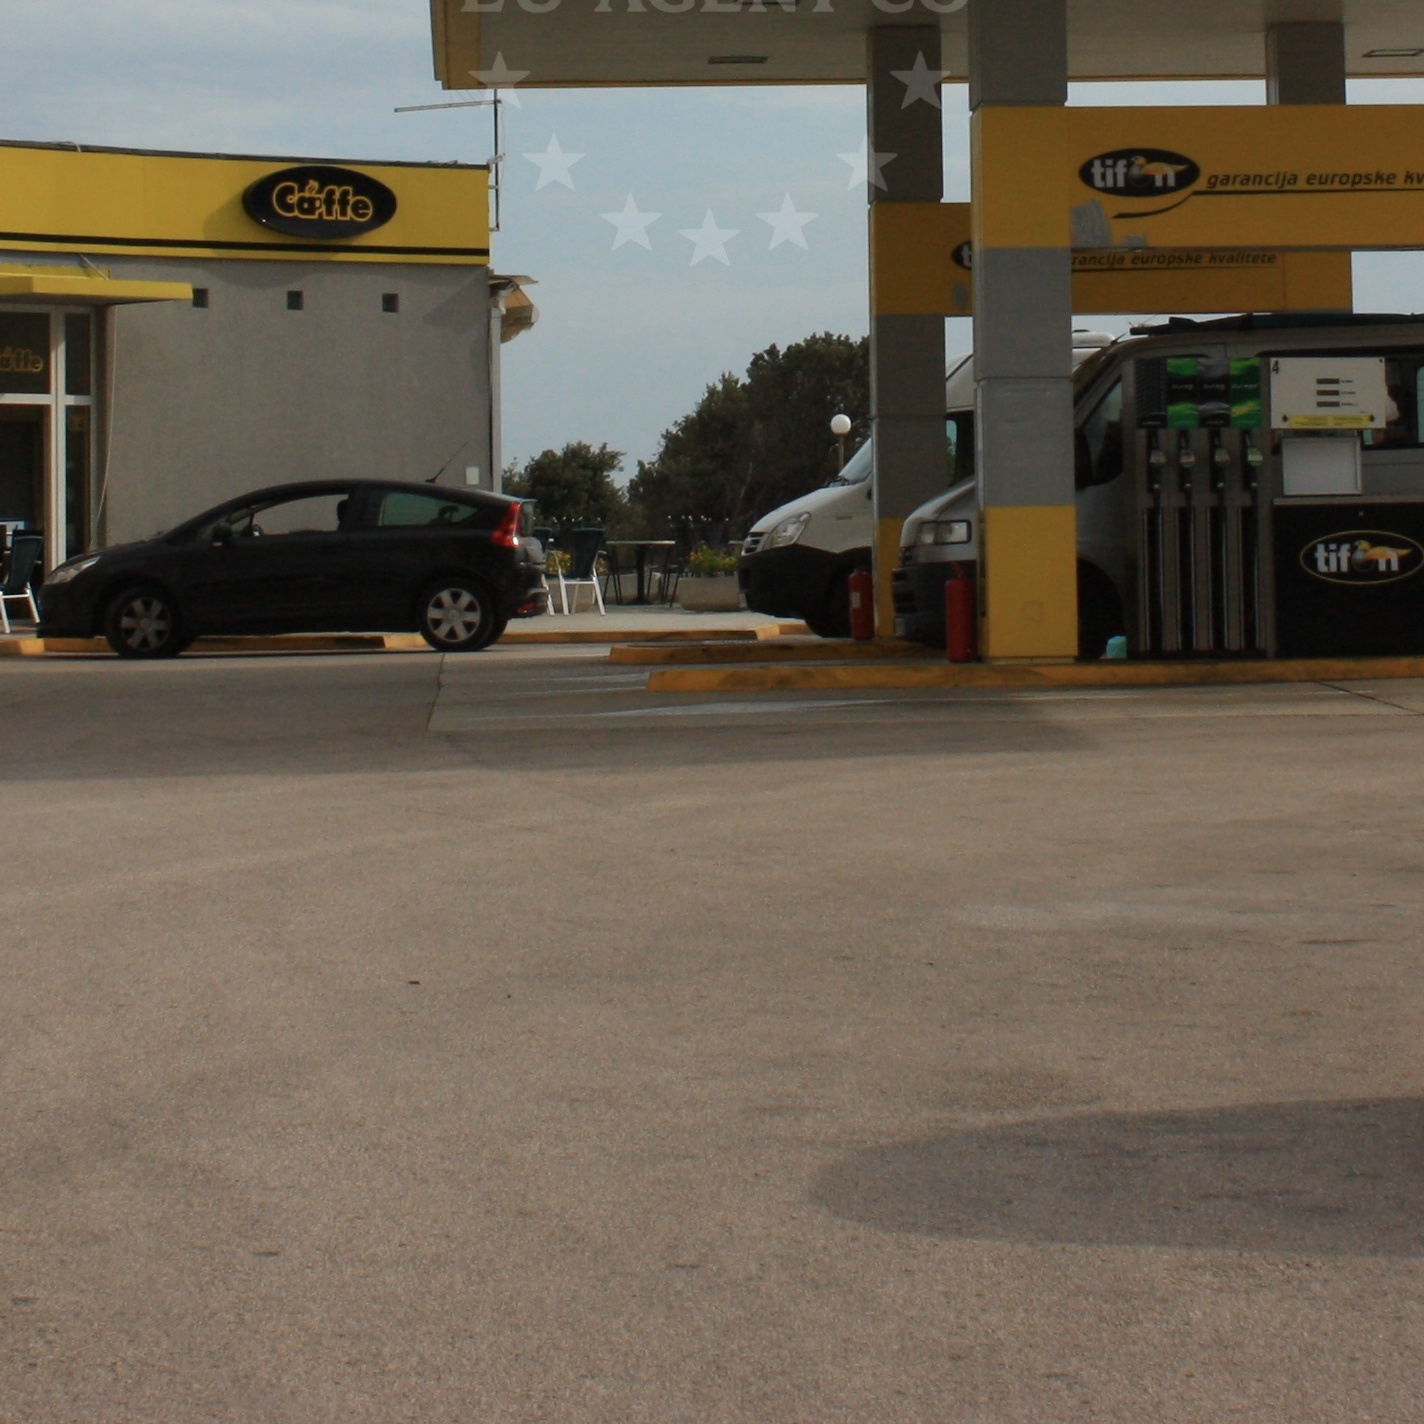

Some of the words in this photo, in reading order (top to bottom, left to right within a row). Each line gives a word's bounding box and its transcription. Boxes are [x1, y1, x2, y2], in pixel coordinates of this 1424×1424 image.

[1206, 170, 1298, 189] garancija
[1305, 170, 1397, 187] europske
[272, 180, 373, 222] Caffe
[1072, 251, 1125, 268] rancija
[1271, 360, 1280, 373] 4
